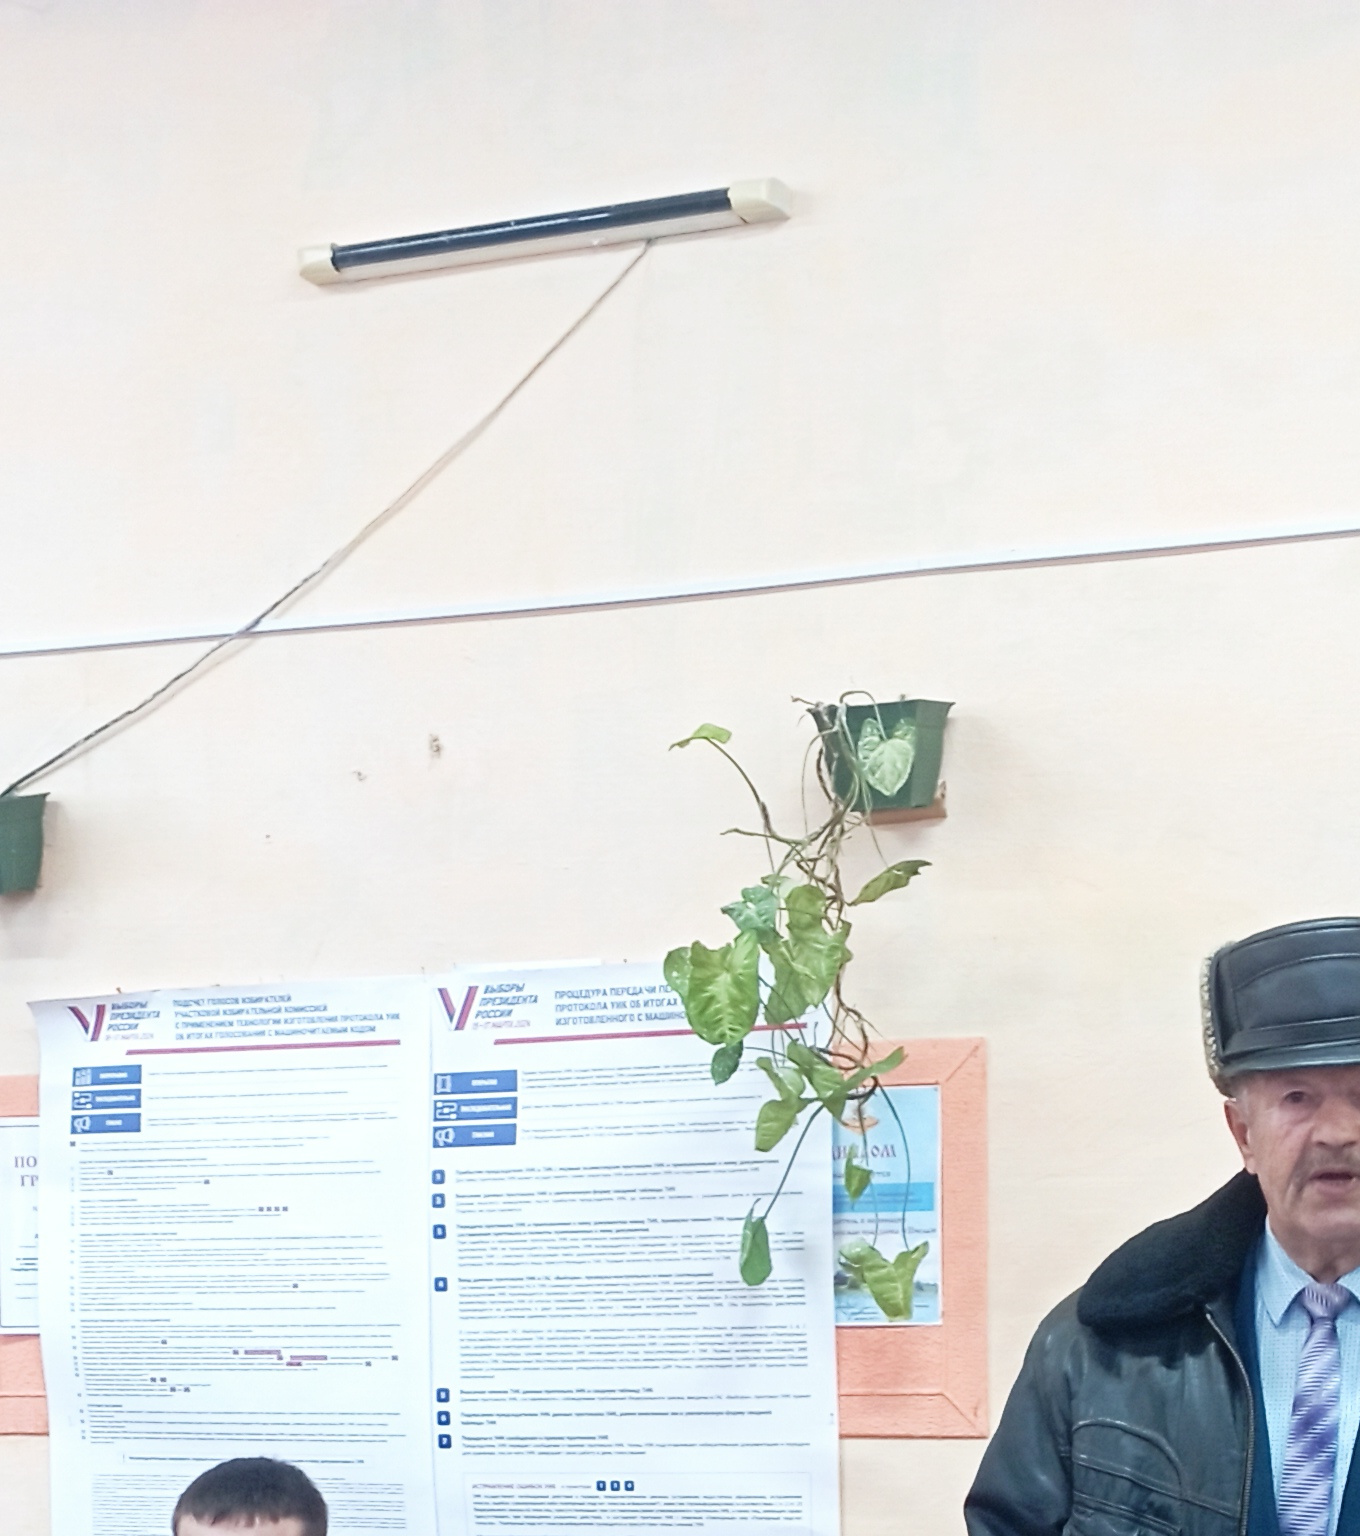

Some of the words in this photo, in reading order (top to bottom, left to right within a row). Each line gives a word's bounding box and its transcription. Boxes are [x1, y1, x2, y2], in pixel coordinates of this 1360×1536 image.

[483, 982, 526, 995] ВЫБОРЫ
[554, 987, 608, 1000] ПРОЦЕДУРА
[609, 984, 657, 997] ПЕРЕДАЧИ
[555, 1001, 608, 1013] ПРОТОКОЛА
[642, 997, 678, 1009] ИТОГАХ
